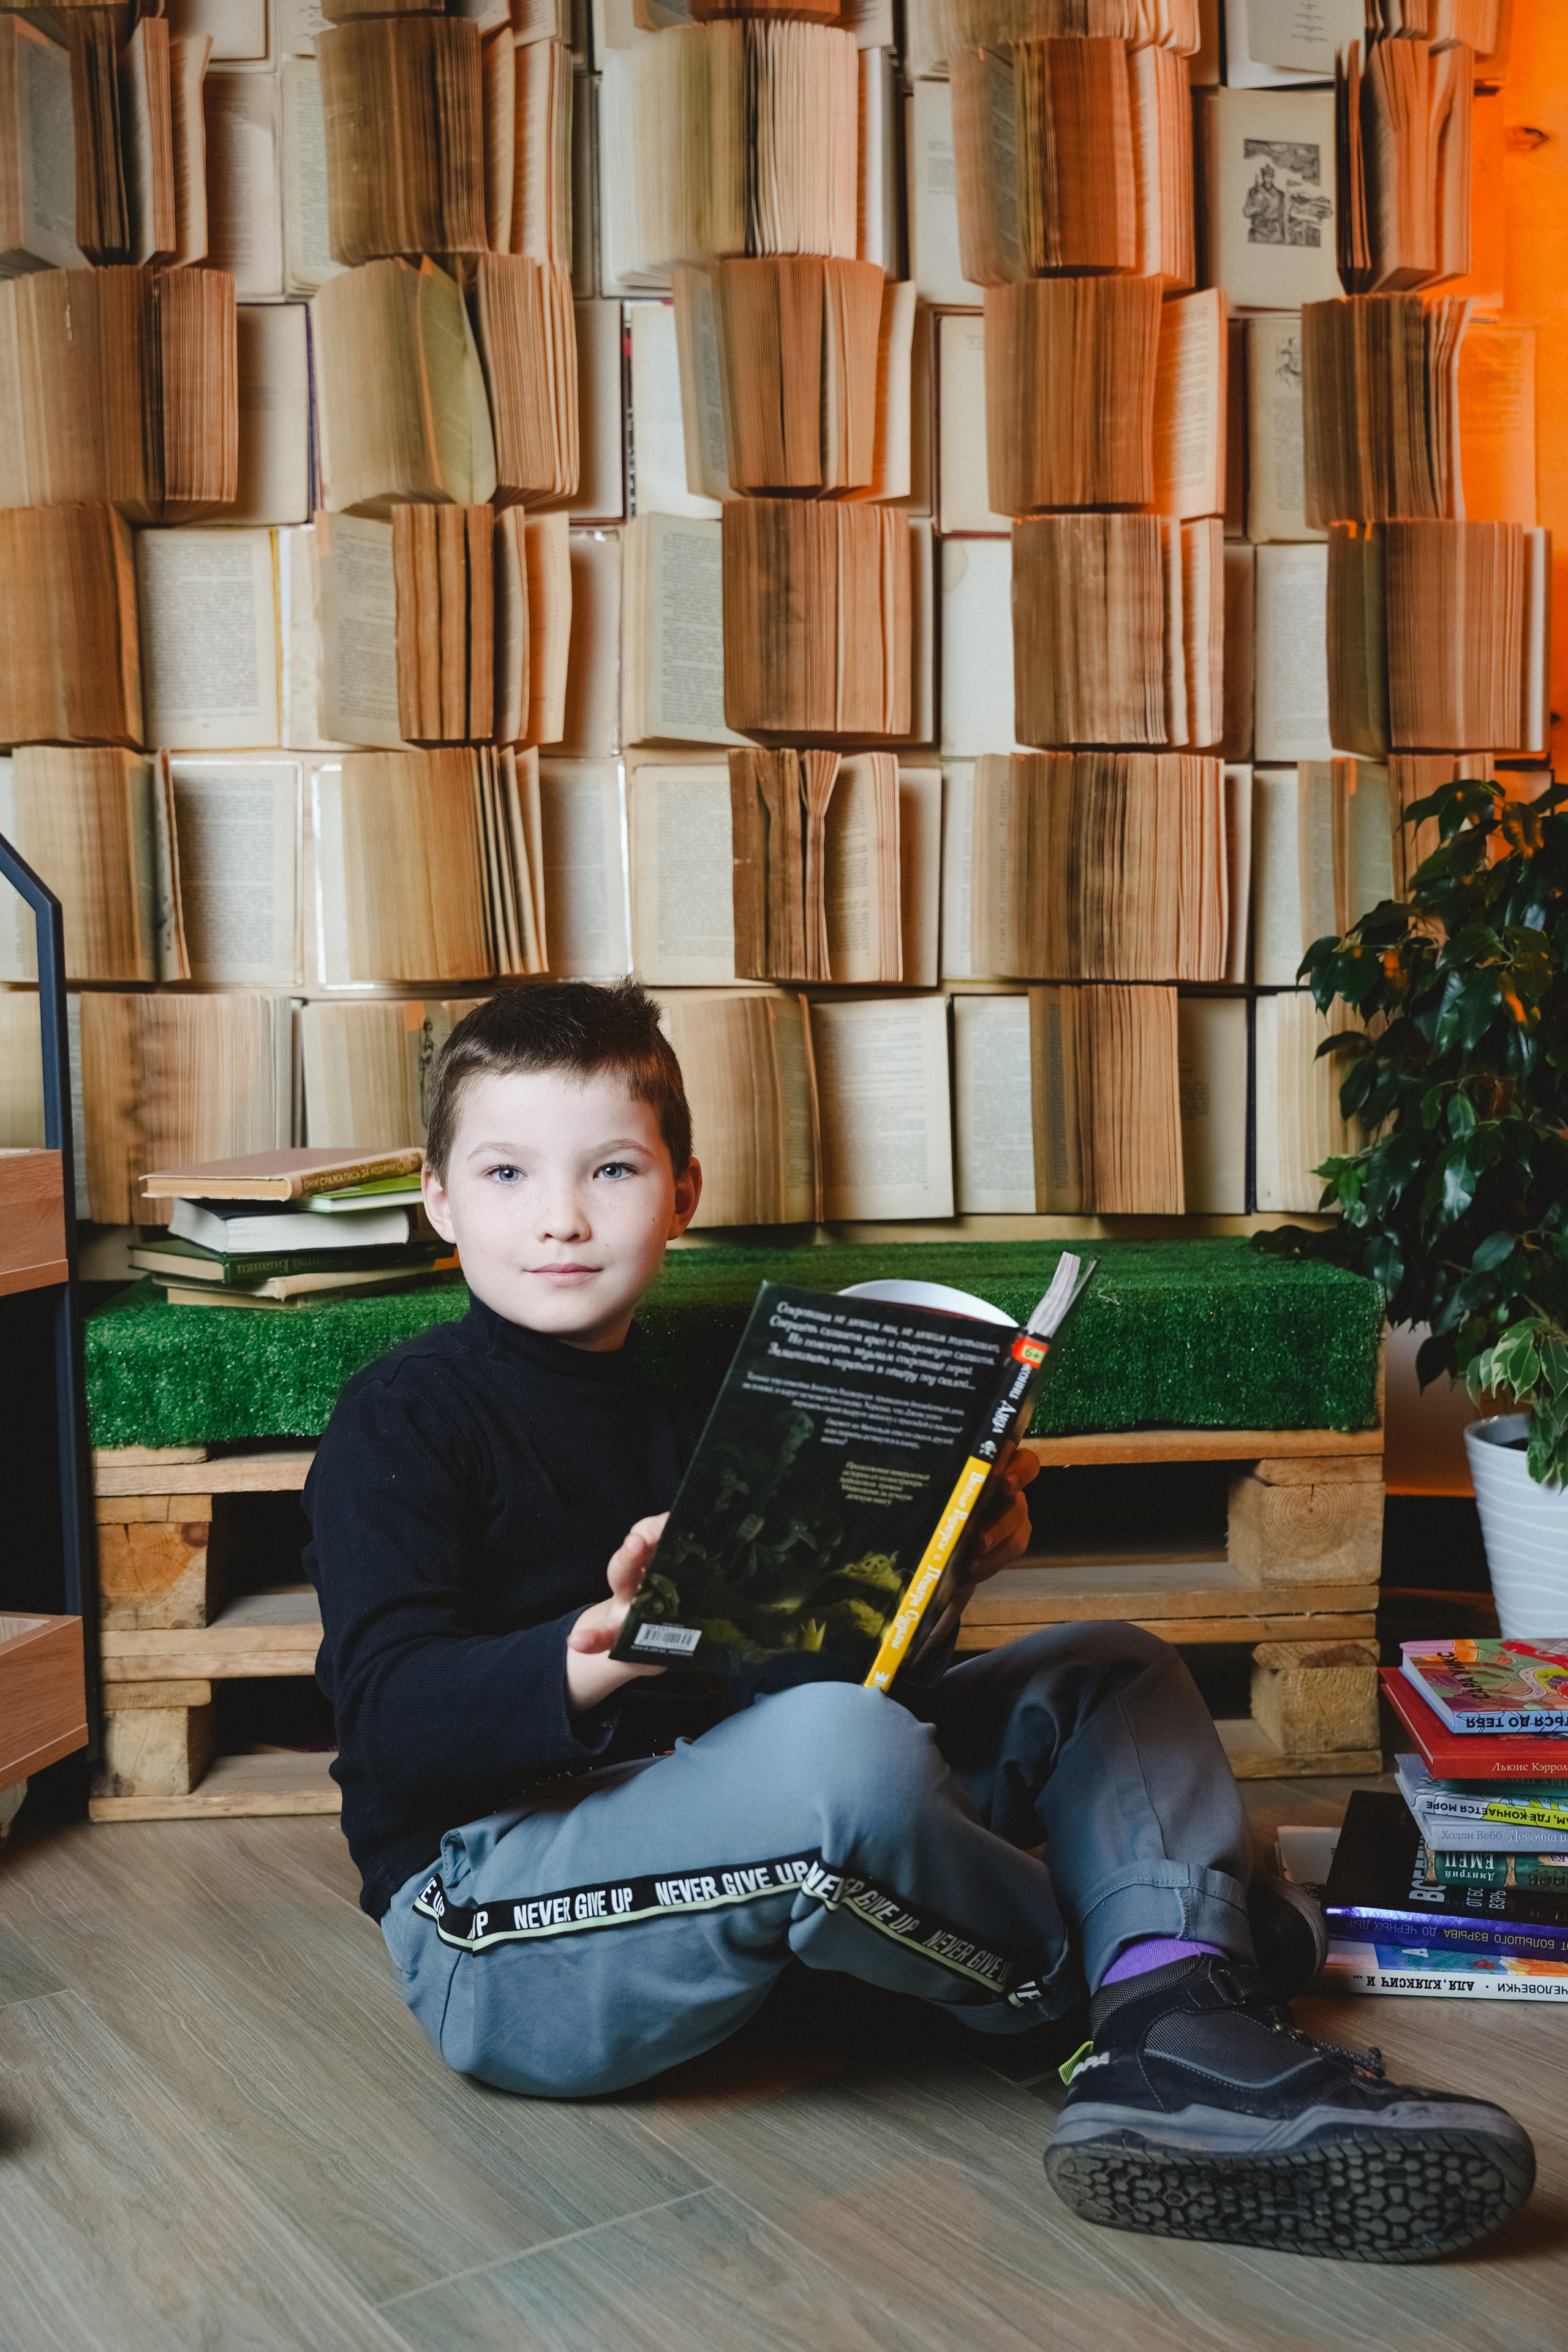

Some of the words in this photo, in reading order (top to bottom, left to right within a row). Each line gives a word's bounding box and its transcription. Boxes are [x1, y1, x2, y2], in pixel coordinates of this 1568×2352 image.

[303, 1179, 319, 1189] ОНИ
[319, 1170, 360, 1186] СРАЖАЛИСЬ
[361, 1167, 371, 1178] ЗА
[371, 1163, 398, 1175] РОДИНУ
[236, 1259, 290, 1274] Бианки
[1024, 1347, 1039, 1359] 6+
[992, 1400, 1017, 1434] Дудл
[909, 1564, 942, 1607] Пещера
[891, 1609, 920, 1649] Судьбы
[1437, 1651, 1471, 1676] УИКС
[1458, 1676, 1491, 1700] САРА
[1466, 1717, 1504, 1728] ТЕБЯ
[1509, 1715, 1530, 1728] ДО
[1491, 1762, 1529, 1771] Льюис
[1532, 1762, 1568, 1774] Кэррол
[1426, 1801, 1457, 1812] МОРЕ
[1460, 1805, 1527, 1820] КОНЧАЕТСЯ
[1530, 1814, 1550, 1823] ГДЕ
[1442, 1830, 1474, 1840] Холли
[1477, 1830, 1503, 1840] Вебб
[1509, 1828, 1557, 1842] Девочка
[654, 1875, 720, 1906] NEVER
[721, 1867, 774, 1896] GIVE
[775, 1860, 809, 1884] UP
[1444, 1870, 1495, 1882] Дмитрий
[513, 1896, 572, 1930] NEVER
[575, 1890, 608, 1920] GIVE
[611, 1887, 633, 1914] UP
[853, 1890, 900, 1921] GIVE
[888, 1913, 921, 1934] UP
[1346, 1918, 1370, 1929] ДЫР
[1374, 1920, 1417, 1934] ЧЕРНЫХ
[1422, 1925, 1437, 1937] ДО
[1443, 1928, 1488, 1942] ВЗРЫВА
[1494, 1934, 1555, 1949] БОЛЬШОГО
[922, 1929, 976, 1962] NEVER
[966, 1950, 1004, 1978] GIVE
[1366, 1975, 1376, 1986] И
[1380, 1976, 1442, 1990] КЛЯКСИЧ
[1497, 1982, 1568, 1996] ЧЕЛОВЕЧКИ
